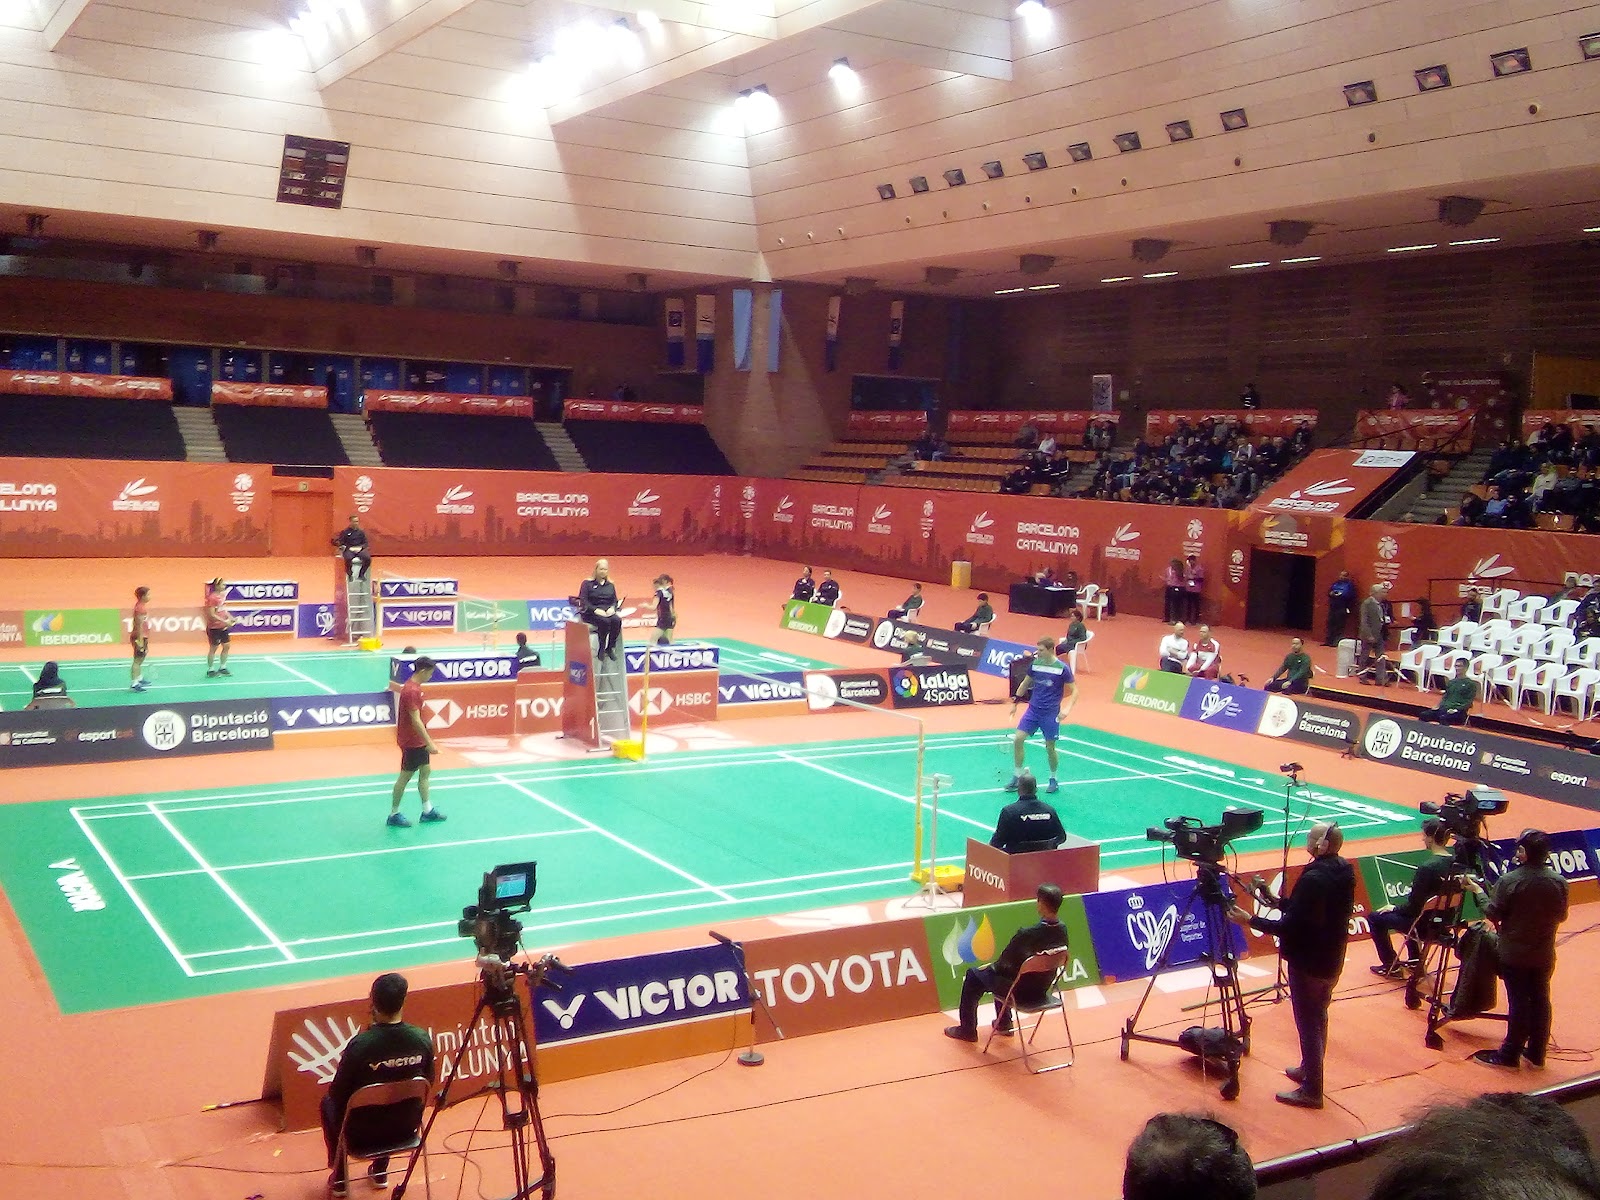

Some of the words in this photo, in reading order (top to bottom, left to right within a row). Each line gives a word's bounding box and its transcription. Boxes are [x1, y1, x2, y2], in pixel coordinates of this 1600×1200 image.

[0, 483, 57, 495] ELONA
[516, 492, 589, 504] BARCELONA
[0, 499, 58, 511] LUNYA
[516, 506, 590, 517] CATALUNYA
[812, 504, 854, 517] BARCELONA
[811, 518, 854, 532] CATALUNYA
[1017, 522, 1080, 538] BARCELONA
[1016, 539, 1079, 556] CATALUNYA
[241, 584, 295, 599] VICTOR
[403, 581, 455, 595] VICTOR
[401, 608, 452, 622] VICTOR
[530, 606, 574, 622] MGS
[122, 615, 207, 633] TYOTA
[41, 632, 113, 645] IBERDROLA
[650, 650, 714, 669] VICTOR
[435, 659, 512, 680] VICTOR
[919, 670, 969, 690] LaLiga
[675, 692, 712, 707] HSBC
[738, 681, 803, 700] VICTOR
[840, 686, 881, 697] Barcelona
[923, 687, 970, 704] 4Sports
[465, 703, 509, 719] HSBC
[516, 697, 563, 719] TOY
[1122, 691, 1176, 714] IBERDROLA
[190, 709, 268, 728] Diputació
[306, 703, 391, 725] VICTOR
[192, 727, 270, 744] Barcelona
[589, 716, 596, 740] 1
[1298, 719, 1348, 740] Barcelona
[1406, 730, 1476, 756] Diputació
[1400, 745, 1472, 772] Barcelona
[1546, 850, 1589, 874] TOR
[967, 863, 1007, 892] TOYOTA
[754, 947, 928, 1008] TOYOTA
[594, 970, 741, 1021] VICTOR
[429, 1017, 517, 1055] minton
[434, 1040, 528, 1082] ALUNYA
